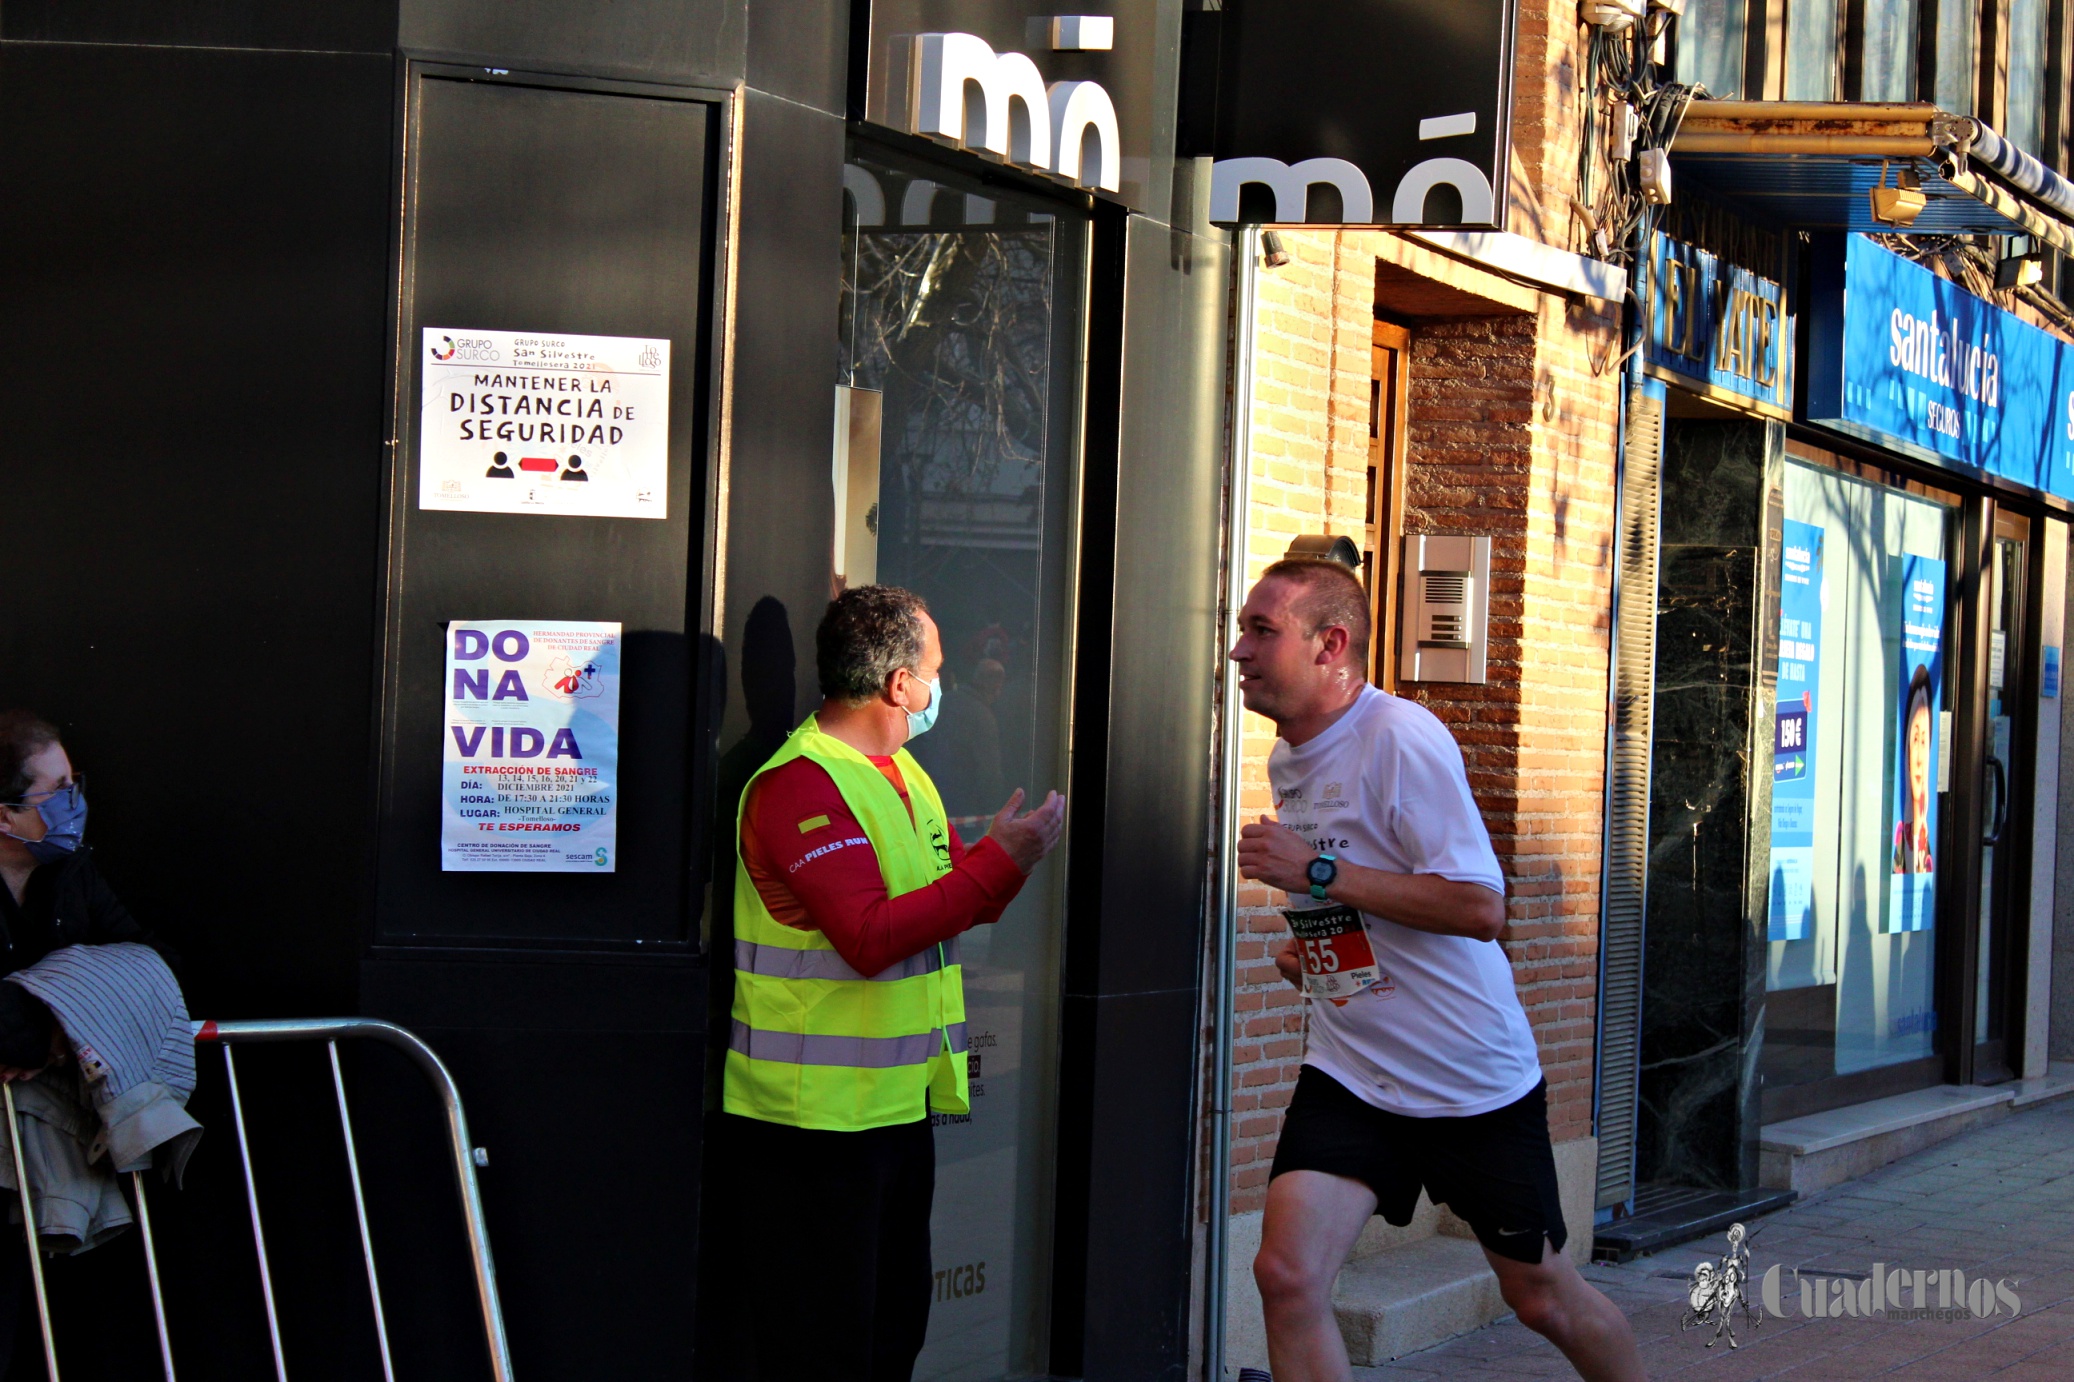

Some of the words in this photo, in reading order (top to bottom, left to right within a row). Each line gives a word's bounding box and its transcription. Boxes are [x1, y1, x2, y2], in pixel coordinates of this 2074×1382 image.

[1663, 258, 1705, 361] EL
[1713, 279, 1777, 387] YATE
[457, 339, 492, 349] GRUPO
[456, 349, 500, 361] SURCO
[513, 348, 535, 357] San
[540, 349, 595, 361] Silvestre
[1890, 307, 1999, 408] santalucía
[513, 359, 569, 369] Tomellosera
[573, 362, 595, 370] 2021
[474, 374, 582, 392] MANTENER
[590, 379, 611, 393] LA
[450, 392, 603, 418] DISTANCIA
[613, 406, 635, 420] DE
[1927, 399, 1961, 439] SEGUROS
[460, 418, 623, 445] SEGURIDAD
[454, 629, 530, 662] DO
[453, 668, 529, 701] NA
[450, 726, 583, 760] VIDA
[463, 765, 534, 775] EXTRACCIÓN
[537, 767, 551, 775] DE
[554, 767, 598, 775] SANGRE
[461, 779, 483, 789] DÍA:
[527, 775, 539, 783] 15,
[541, 775, 553, 783] 16,
[555, 775, 567, 783] 20,
[497, 783, 553, 791] DICIEMBRE
[460, 795, 495, 803] HORA:
[498, 794, 511, 802] DE
[549, 795, 572, 803] 21:30
[574, 795, 610, 803] HORAS
[460, 809, 500, 817] LUGAR:
[504, 806, 555, 814] HOSPITAL
[558, 807, 606, 815] GENERAL
[478, 823, 495, 831] TE
[499, 823, 581, 831] ESPERAMOS
[788, 858, 806, 874] CAA
[805, 840, 844, 862] PIELES
[1299, 915, 1352, 930] Silvestre
[1305, 938, 1340, 974] 55
[1351, 971, 1372, 980] Pieles
